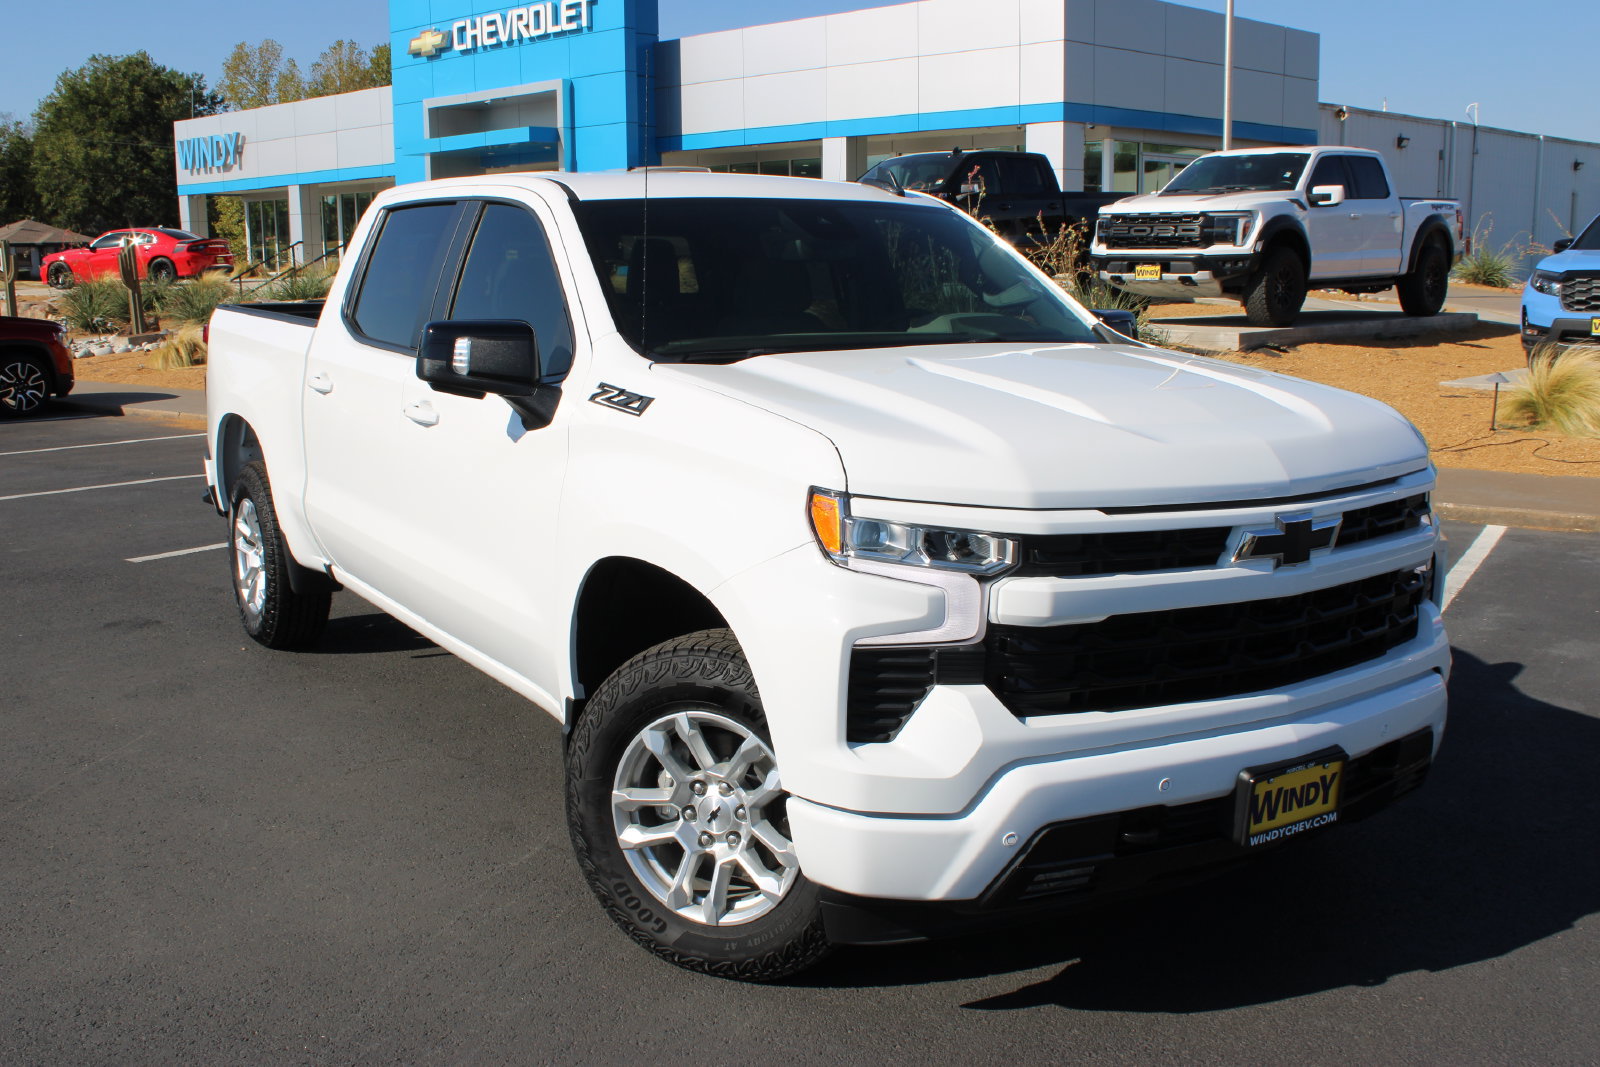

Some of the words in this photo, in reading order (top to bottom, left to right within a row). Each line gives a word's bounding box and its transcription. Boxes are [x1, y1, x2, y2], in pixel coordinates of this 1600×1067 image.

[452, 0, 598, 51] CHEVROLET
[177, 132, 241, 170] WINDY
[1110, 225, 1200, 237] FORD
[1136, 269, 1160, 277] WINDY
[588, 381, 656, 417] Z71
[1250, 772, 1338, 825] WINDY
[1250, 812, 1337, 846] WINDYCHEV.COM
